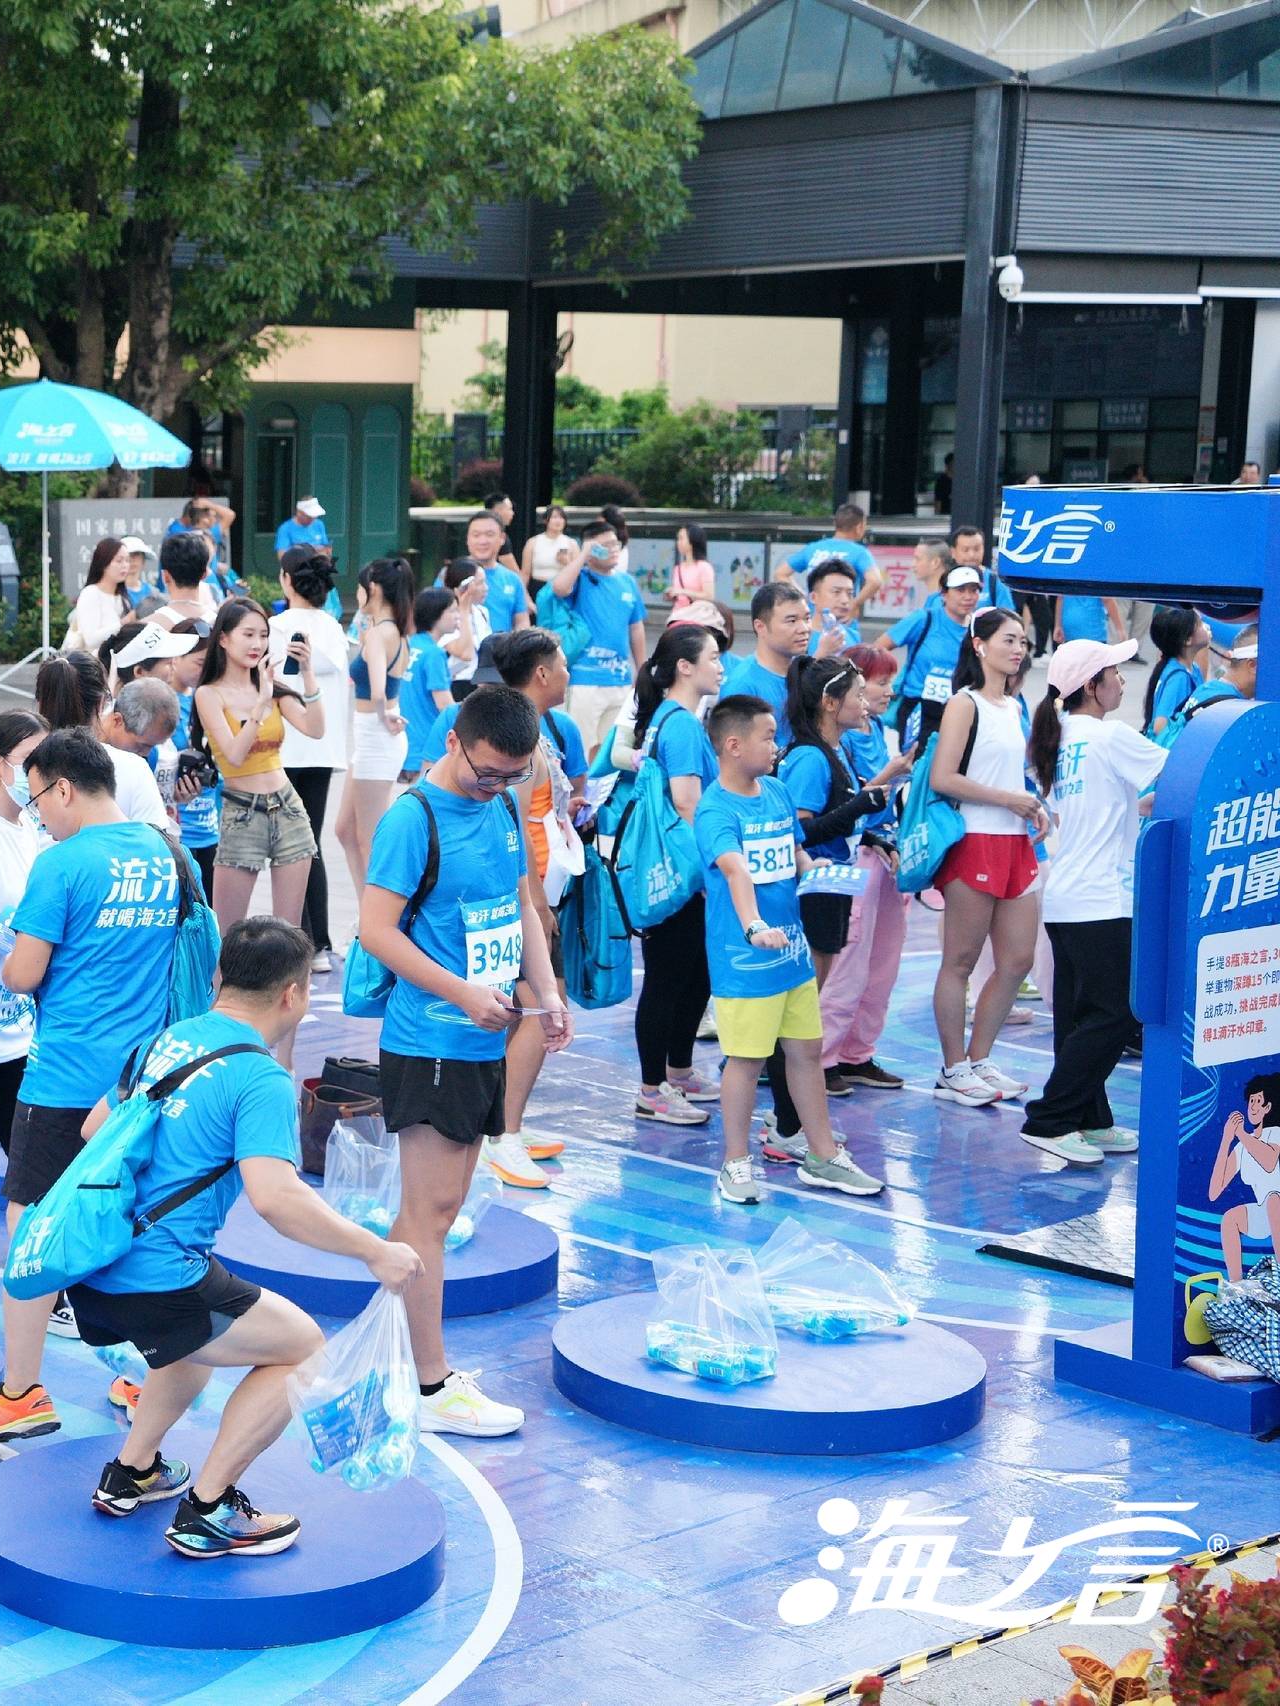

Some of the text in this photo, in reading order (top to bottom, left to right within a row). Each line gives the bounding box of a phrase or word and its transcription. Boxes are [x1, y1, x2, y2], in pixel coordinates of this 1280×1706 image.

[75, 517, 175, 537] 国家级风景
[102, 856, 179, 905] 流汗
[1200, 847, 1280, 919] 力量
[95, 906, 179, 929] 就喝海之言
[472, 933, 522, 976] 3948
[1203, 993, 1280, 1019] 战成功，挑战完成
